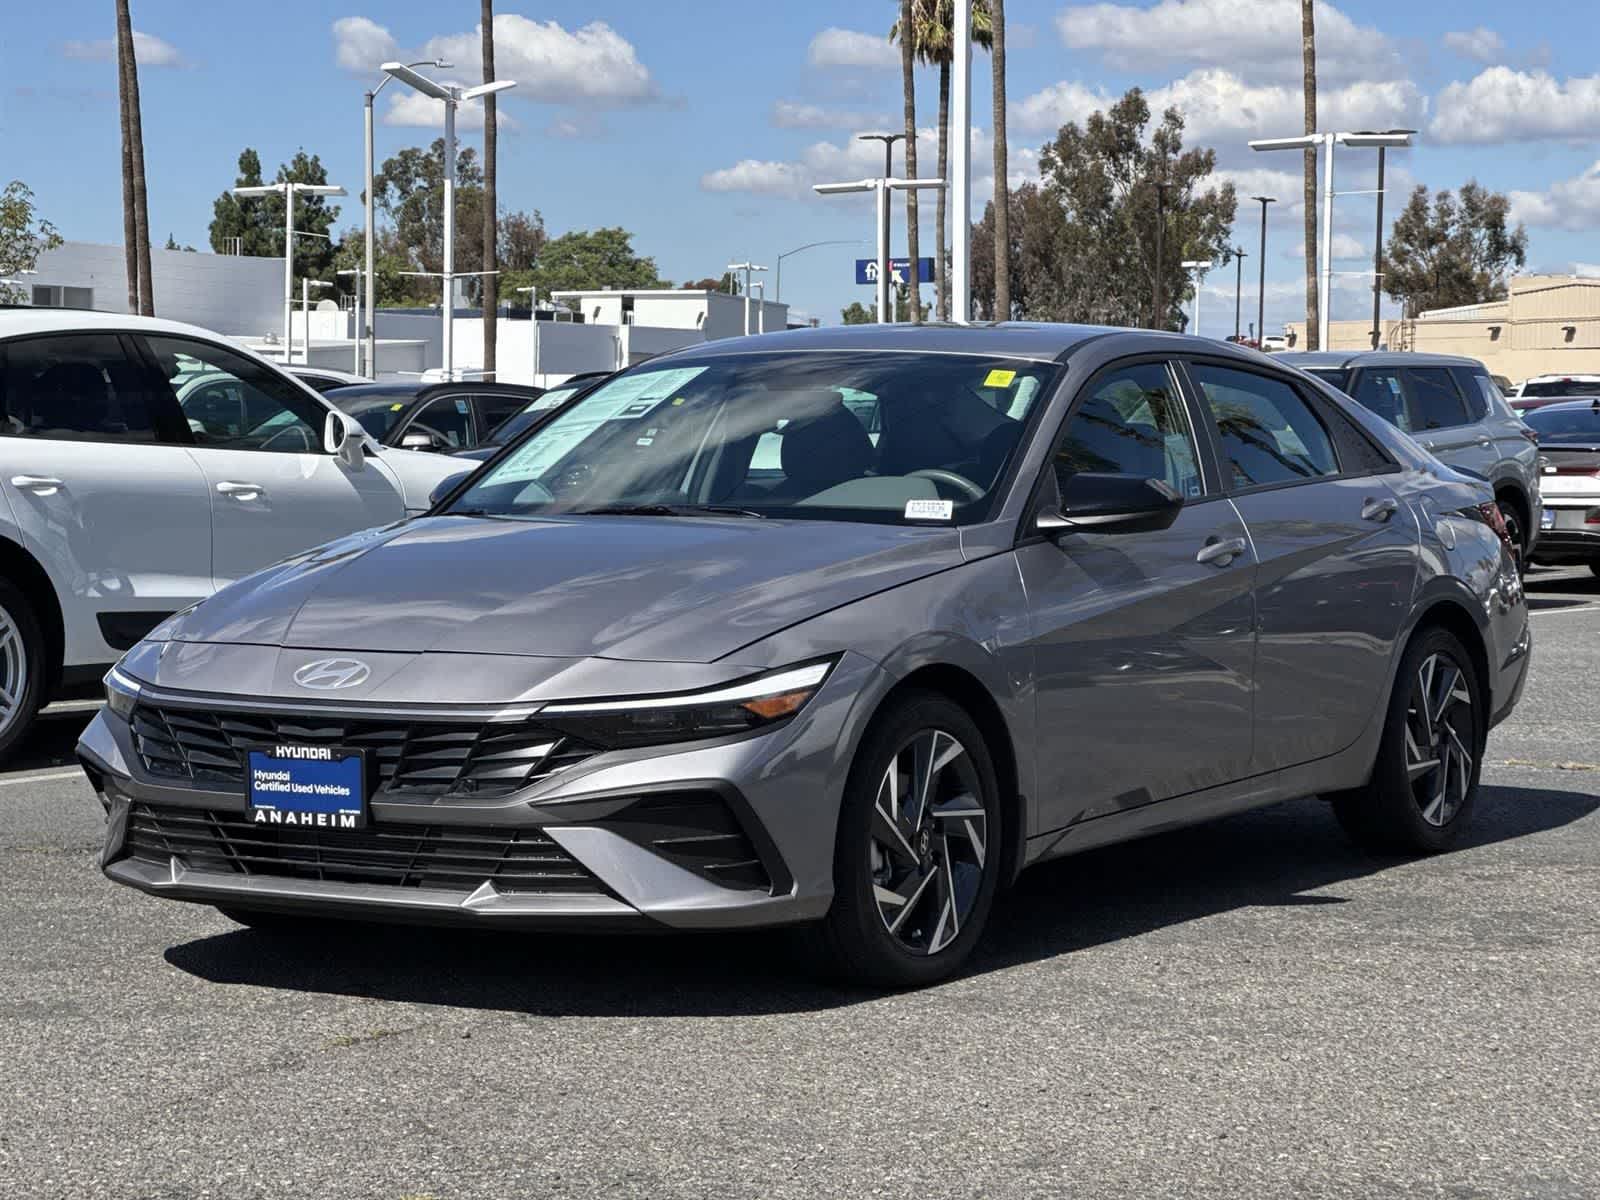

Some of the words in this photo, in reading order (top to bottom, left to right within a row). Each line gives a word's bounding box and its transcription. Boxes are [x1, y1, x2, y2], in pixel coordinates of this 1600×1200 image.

[275, 745, 332, 761] HYUNDAI
[254, 769, 291, 782] Hyundai
[254, 781, 290, 793] Certified
[291, 783, 314, 794] Used
[314, 784, 350, 796] Vehicles
[254, 809, 356, 828] ANAHEIM
